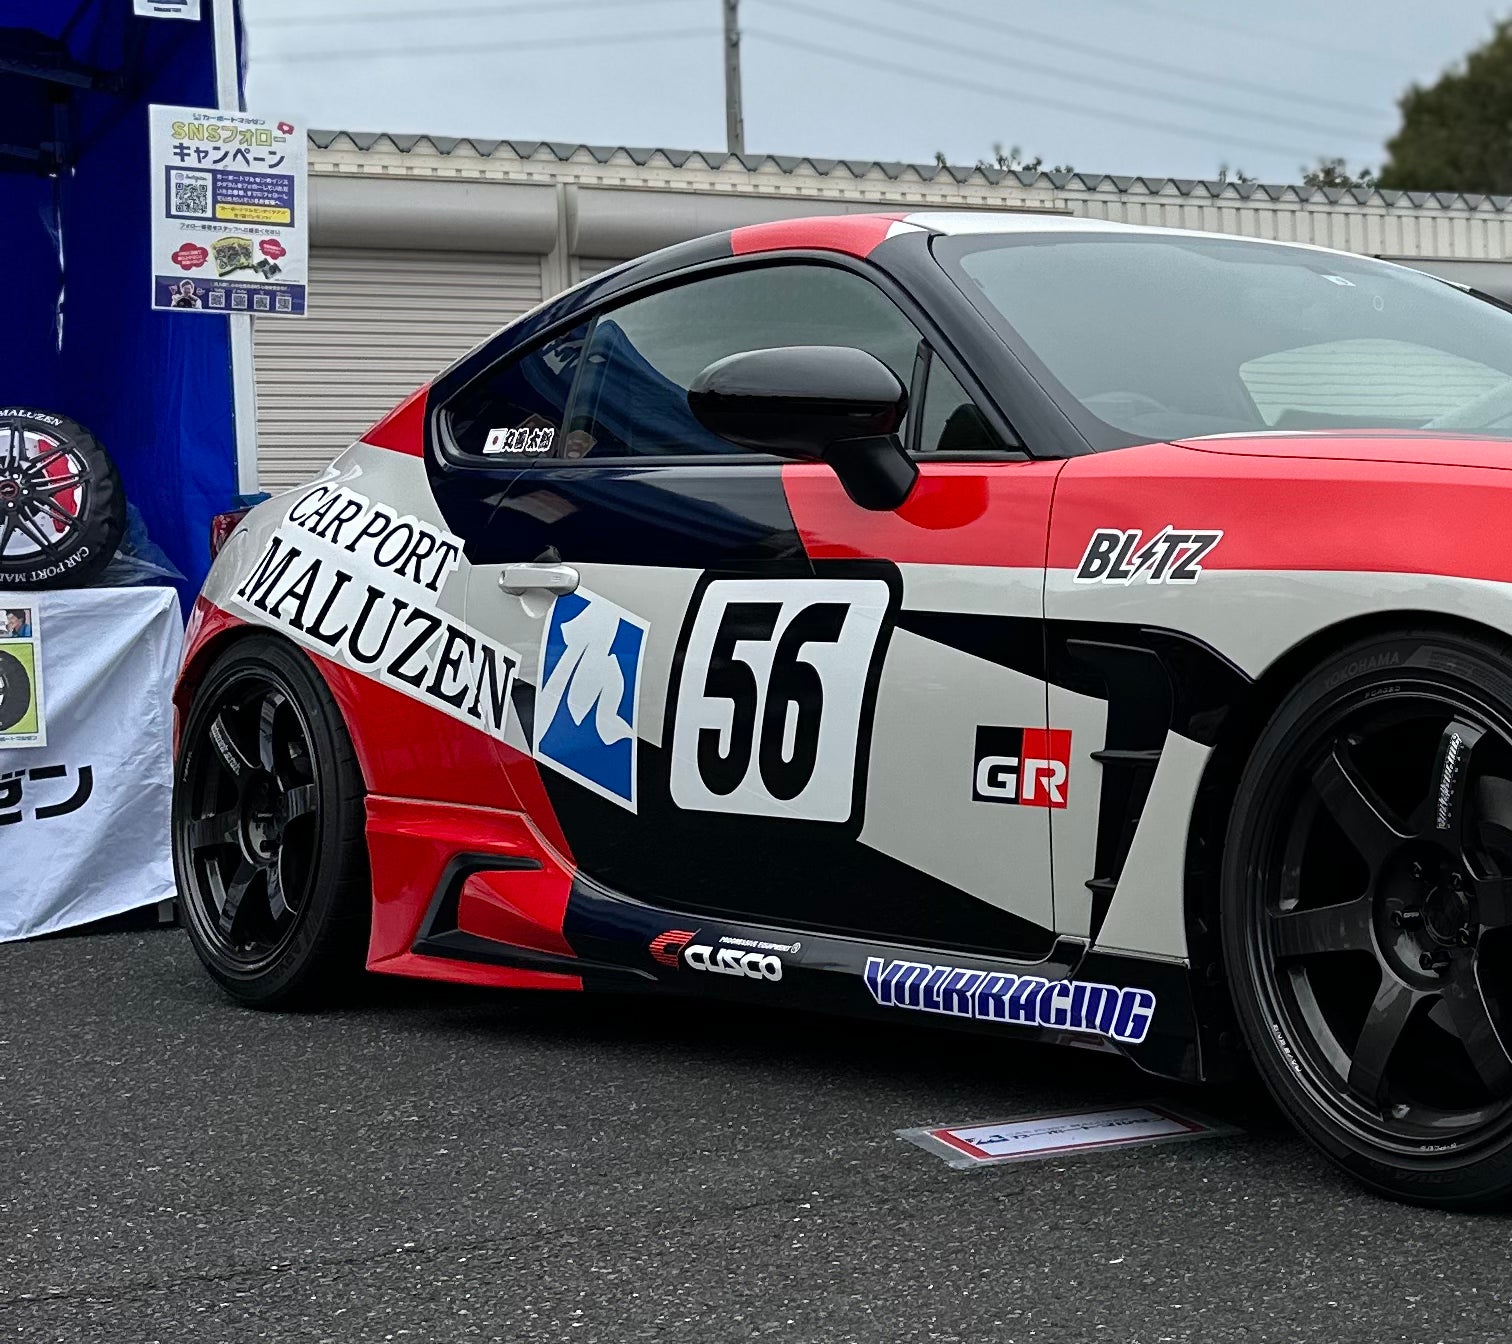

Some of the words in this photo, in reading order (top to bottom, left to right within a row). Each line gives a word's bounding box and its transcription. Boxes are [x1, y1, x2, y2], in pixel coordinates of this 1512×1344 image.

[171, 121, 287, 147] SNSフォロー
[172, 142, 286, 169] キャンペーン
[288, 485, 363, 545] CAR
[344, 510, 460, 592] PORT
[1075, 526, 1223, 585] BLITZ
[237, 536, 518, 730] MALUZEN
[696, 601, 852, 801] 56
[976, 755, 1067, 803] GR
[684, 944, 783, 982] CUSCO
